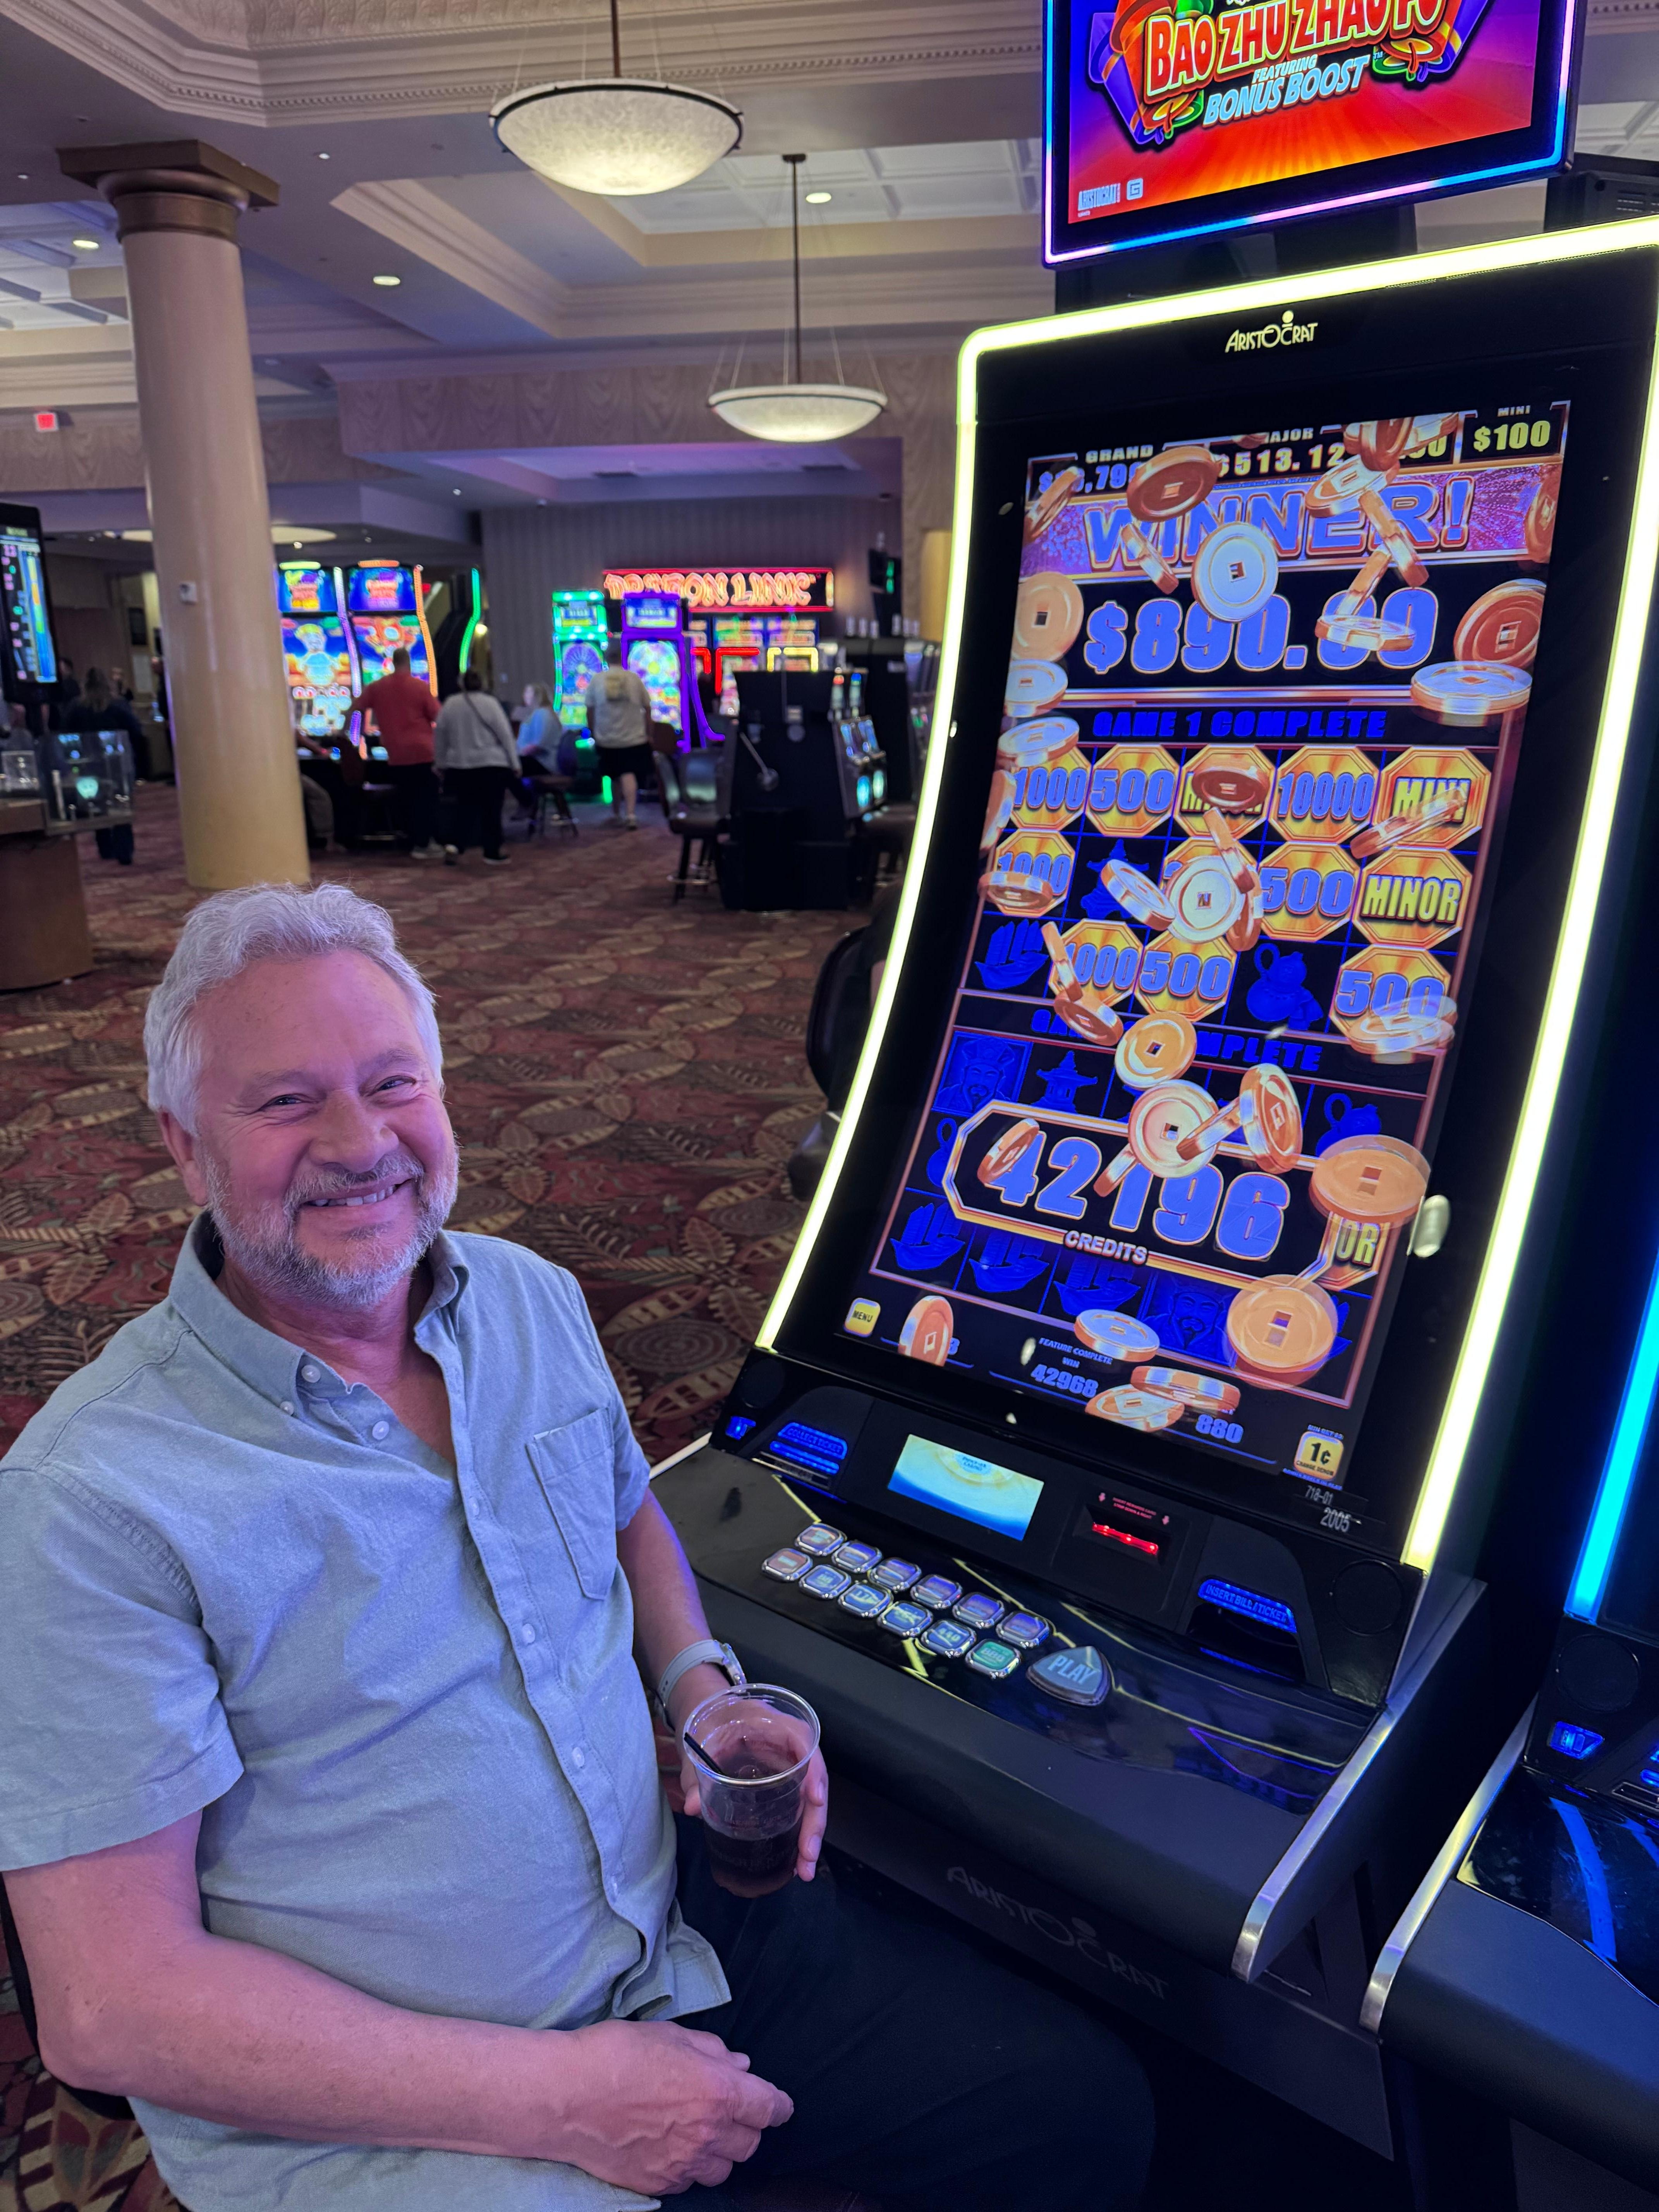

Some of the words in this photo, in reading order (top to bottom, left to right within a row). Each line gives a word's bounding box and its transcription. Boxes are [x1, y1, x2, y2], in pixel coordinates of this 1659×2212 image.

[1146, 15, 1216, 97] BAO
[1217, 0, 1289, 74] ZHU
[1252, 54, 1318, 84] FEATURING
[1202, 81, 1284, 126] BONUS
[1283, 54, 1370, 106] BOOST
[1224, 318, 1318, 353] ARISTOCRAT
[1497, 405, 1531, 417] MINI
[1265, 427, 1314, 443] AJOR
[1473, 420, 1551, 452] $100
[1085, 444, 1154, 464] GRAND
[1084, 476, 1474, 570] WINNER!
[1092, 710, 1177, 737] GAME
[1186, 711, 1202, 737] 1
[1210, 709, 1388, 738] COMPLETE
[1013, 767, 1087, 811] 1000
[1089, 768, 1175, 813] 500
[1278, 772, 1375, 820] 10000
[1260, 867, 1355, 917] 500
[1360, 874, 1463, 924] MINOR
[1140, 950, 1233, 1000] 500
[1335, 969, 1445, 1018] 500
[1196, 1030, 1323, 1071] MPLETE
[984, 1130, 1290, 1260] 42196
[1064, 1230, 1148, 1265] CREDITS
[852, 1310, 873, 1323] MENU
[1038, 1337, 1073, 1353] FEATURE
[1073, 1347, 1113, 1365] COMPLETE
[1062, 1357, 1080, 1369] WIN
[1030, 1364, 1099, 1398] 42968
[1195, 1414, 1244, 1444] 880
[1320, 1506, 1352, 1533] 2005
[1206, 1584, 1235, 1603] INSERT
[1047, 1654, 1097, 1685] PLAY
